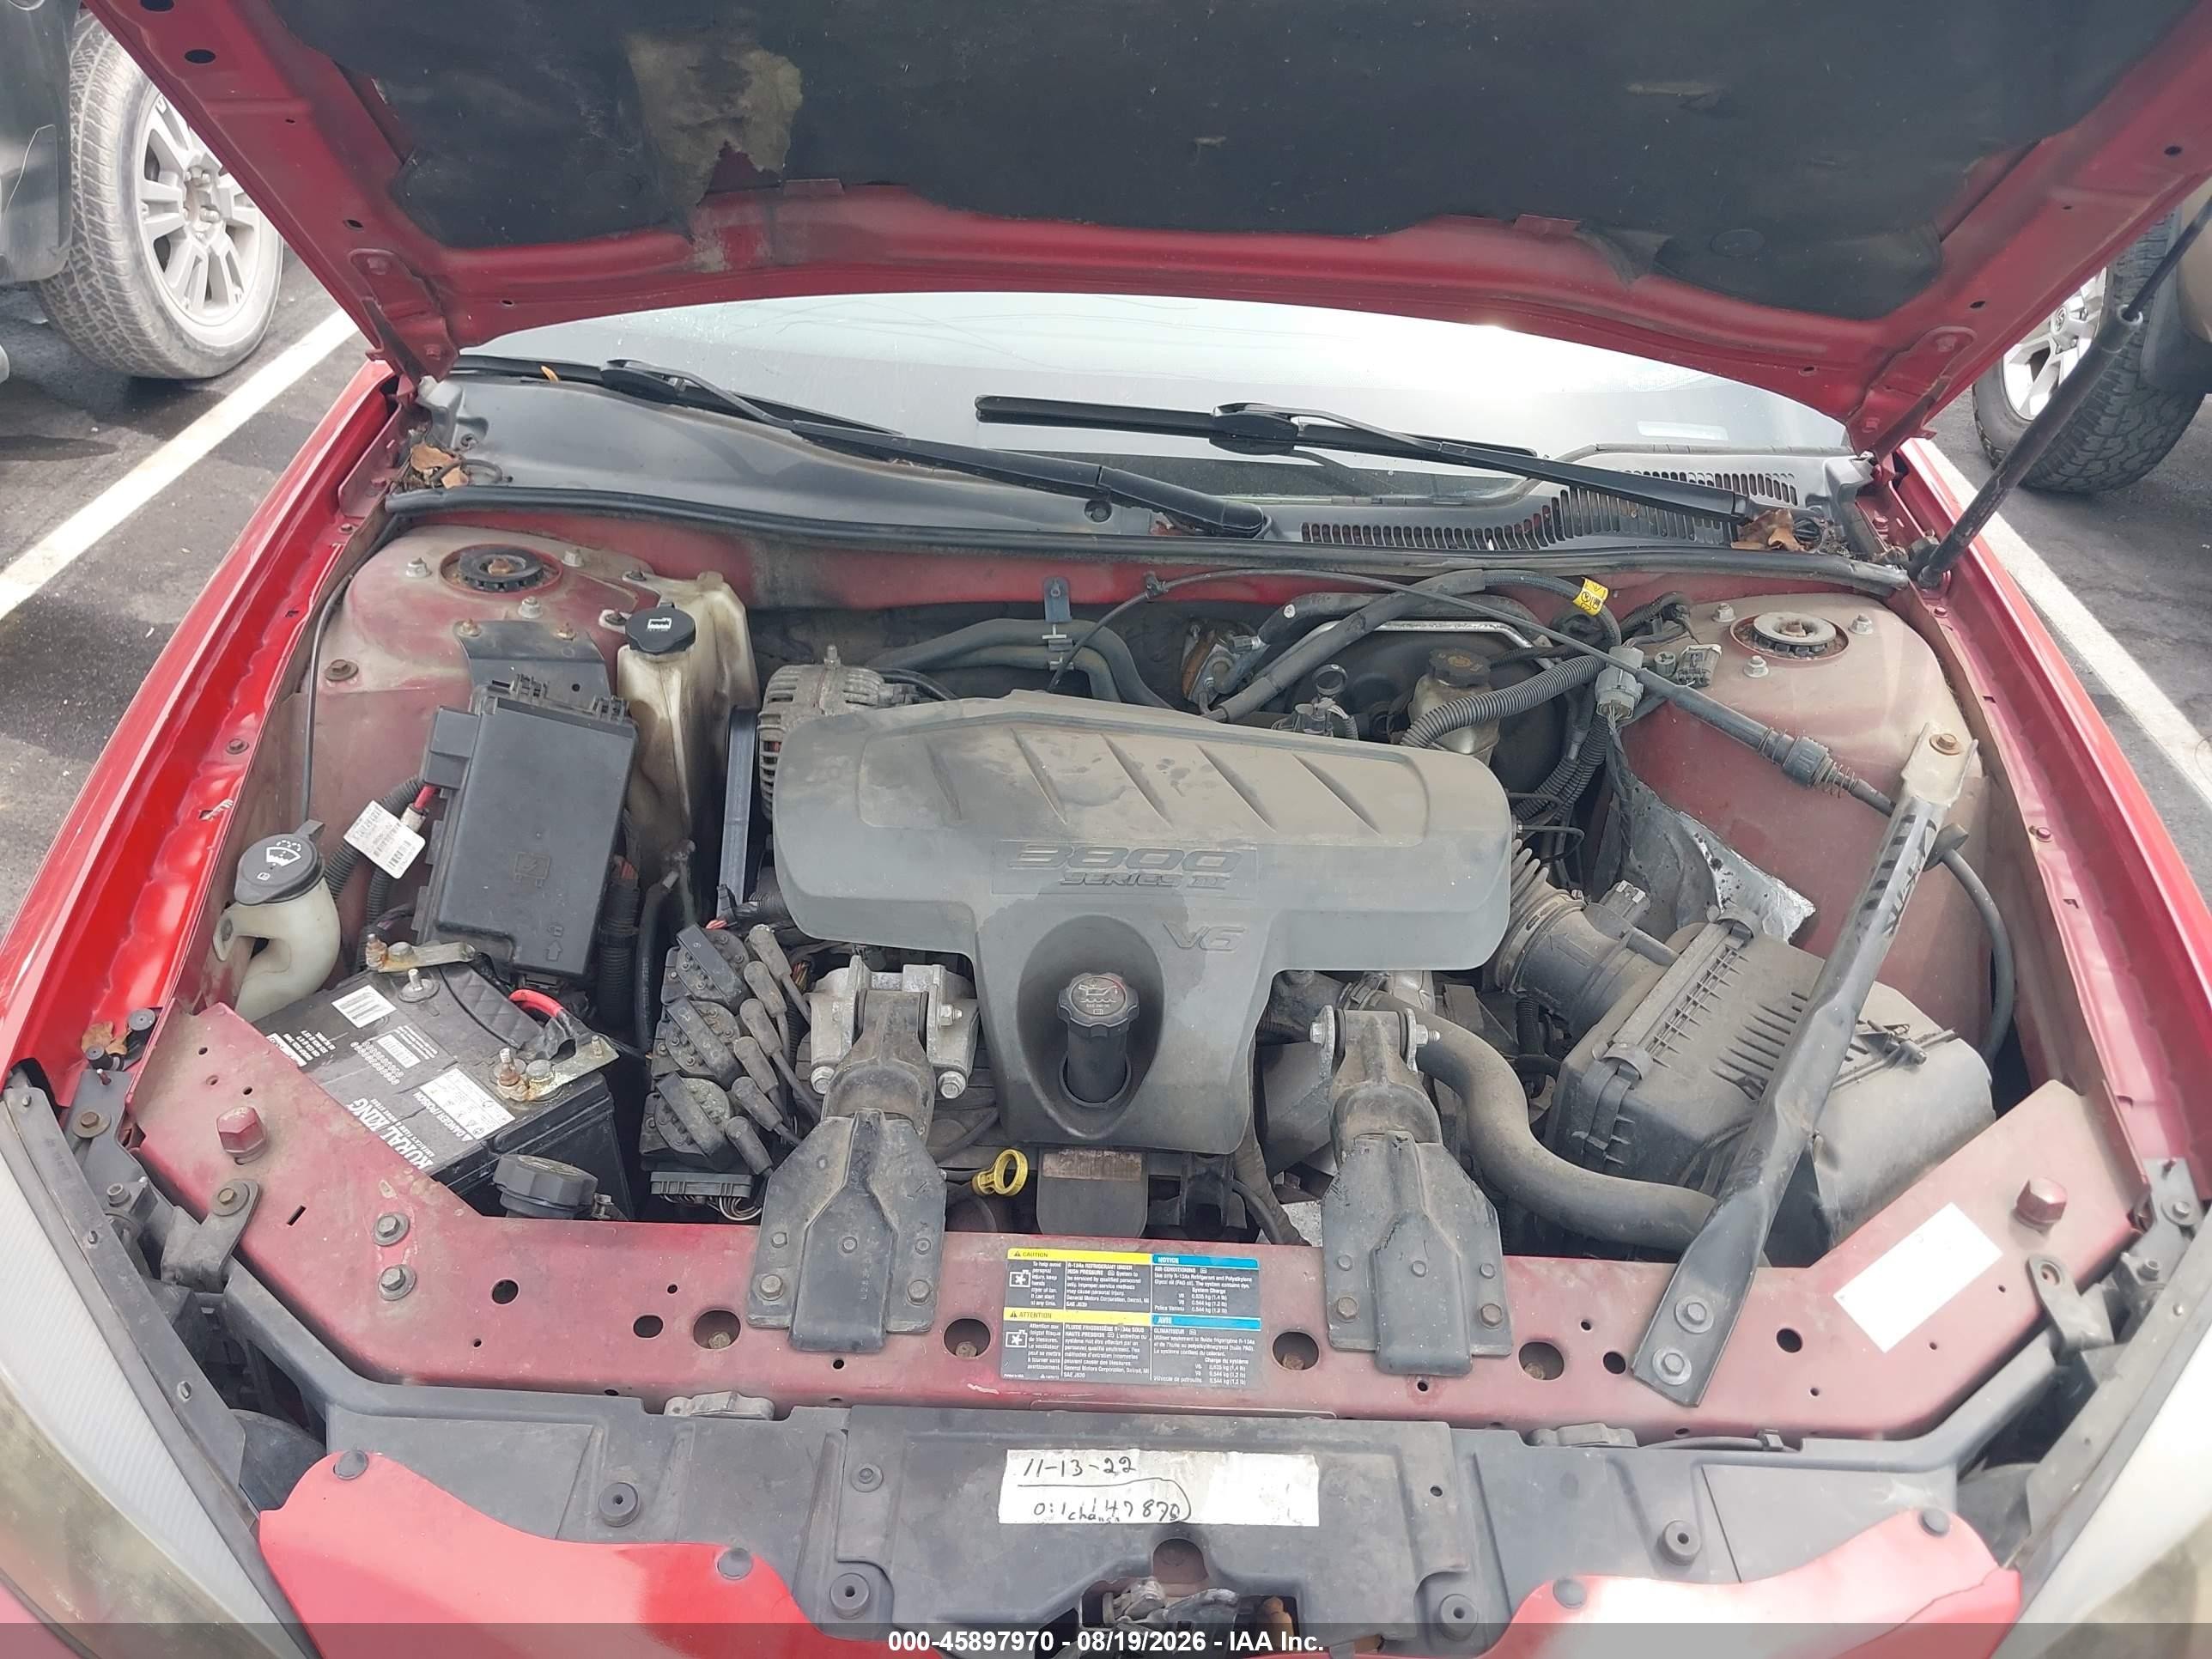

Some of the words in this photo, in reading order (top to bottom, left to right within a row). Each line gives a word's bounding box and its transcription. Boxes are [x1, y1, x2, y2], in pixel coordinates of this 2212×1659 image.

[1008, 844, 1243, 872] 3800
[1058, 872, 1182, 888] SERIES
[1163, 921, 1247, 951] V6
[346, 1097, 386, 1132] KING
[1024, 1456, 1136, 1477] 11-13-22
